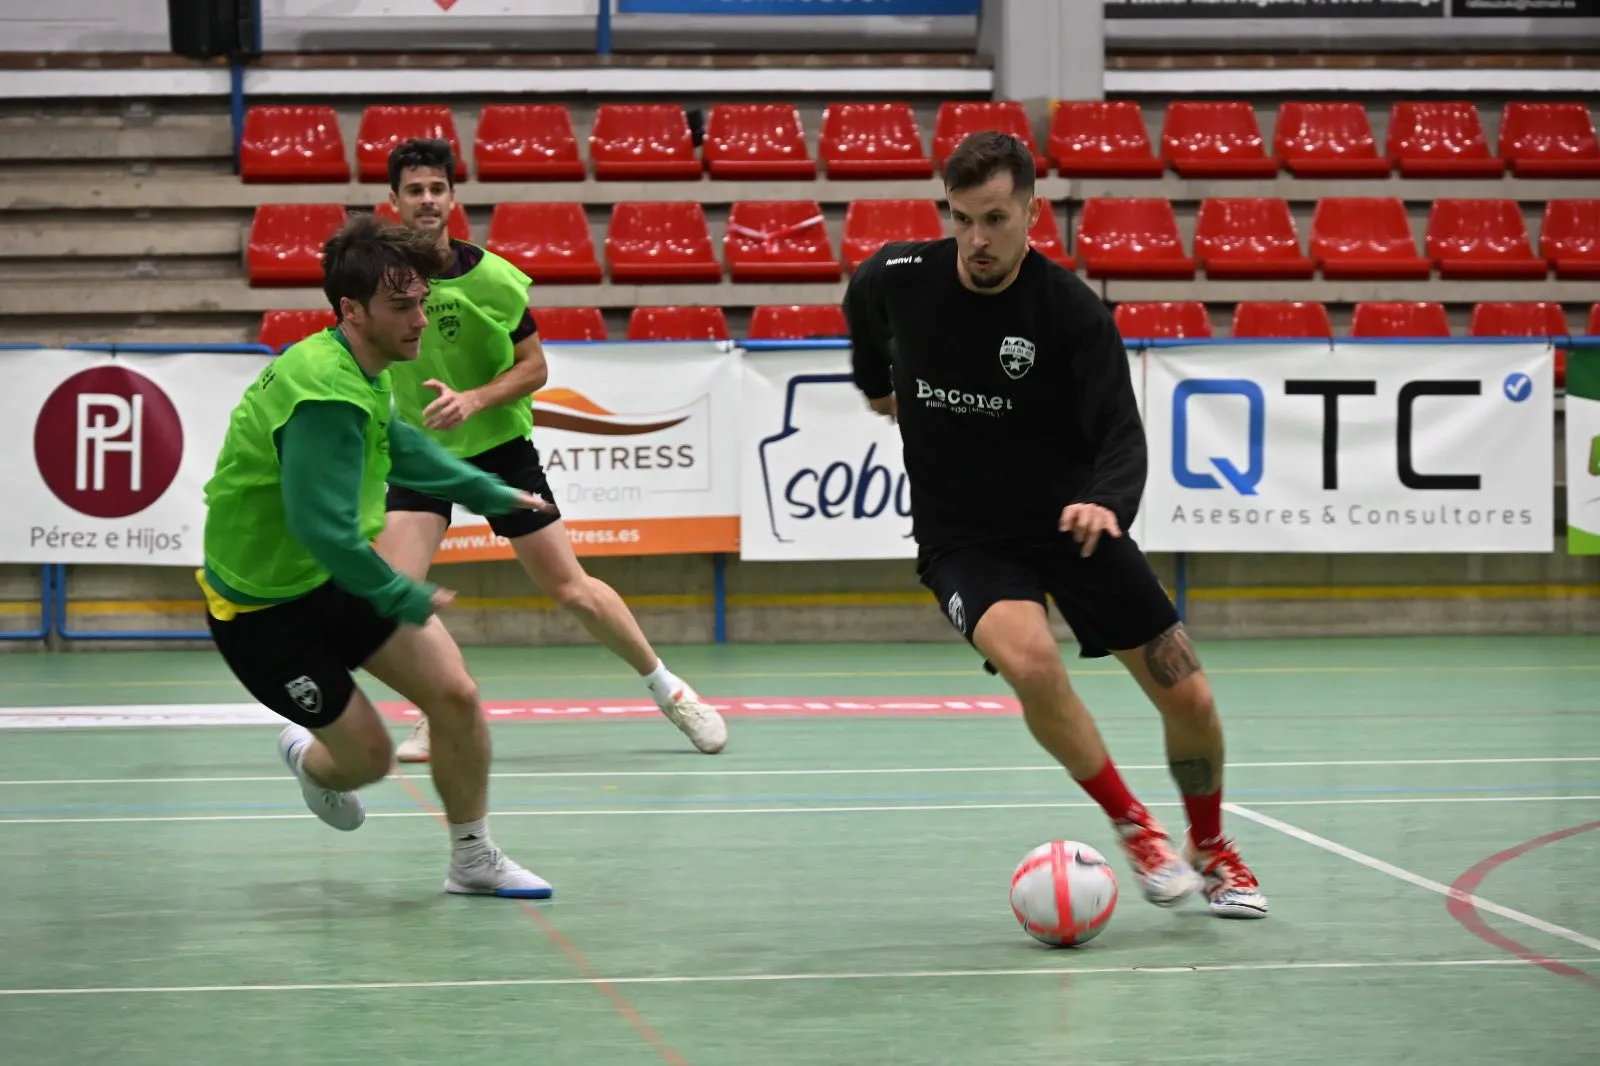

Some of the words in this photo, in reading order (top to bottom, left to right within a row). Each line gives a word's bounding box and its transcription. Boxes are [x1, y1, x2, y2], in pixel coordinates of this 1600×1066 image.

[76, 393, 143, 491] PH
[1172, 379, 1481, 496] QTC
[540, 445, 695, 472] ATTRESS
[566, 483, 642, 504] Dream
[1171, 505, 1312, 525] Asesores
[1322, 505, 1338, 525] &
[1349, 504, 1533, 526] Consultores
[30, 525, 98, 549] Pérez
[104, 531, 120, 549] e
[126, 526, 183, 555] Hijos
